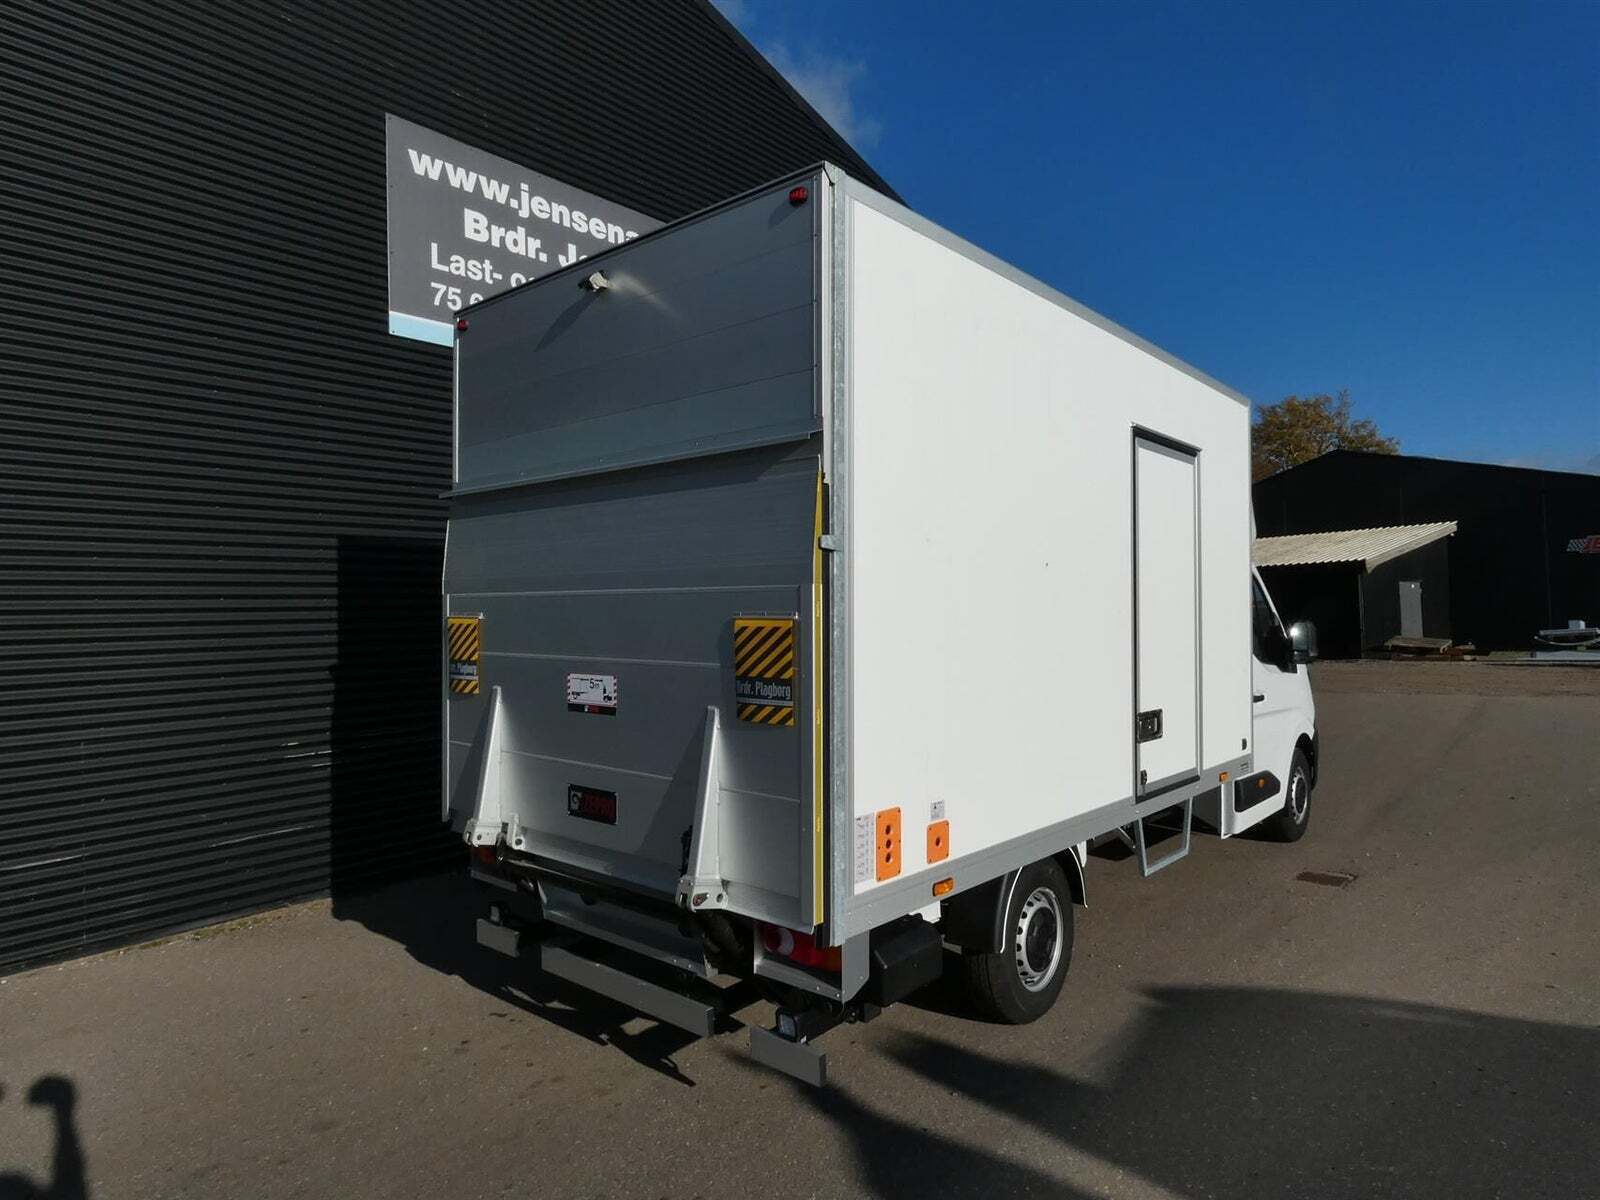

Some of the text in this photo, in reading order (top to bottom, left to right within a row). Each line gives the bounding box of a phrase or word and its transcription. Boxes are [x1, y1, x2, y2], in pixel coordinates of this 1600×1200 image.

[463, 207, 589, 267] Brdr. J
[430, 242, 502, 285] Last-
[430, 281, 462, 311] 75
